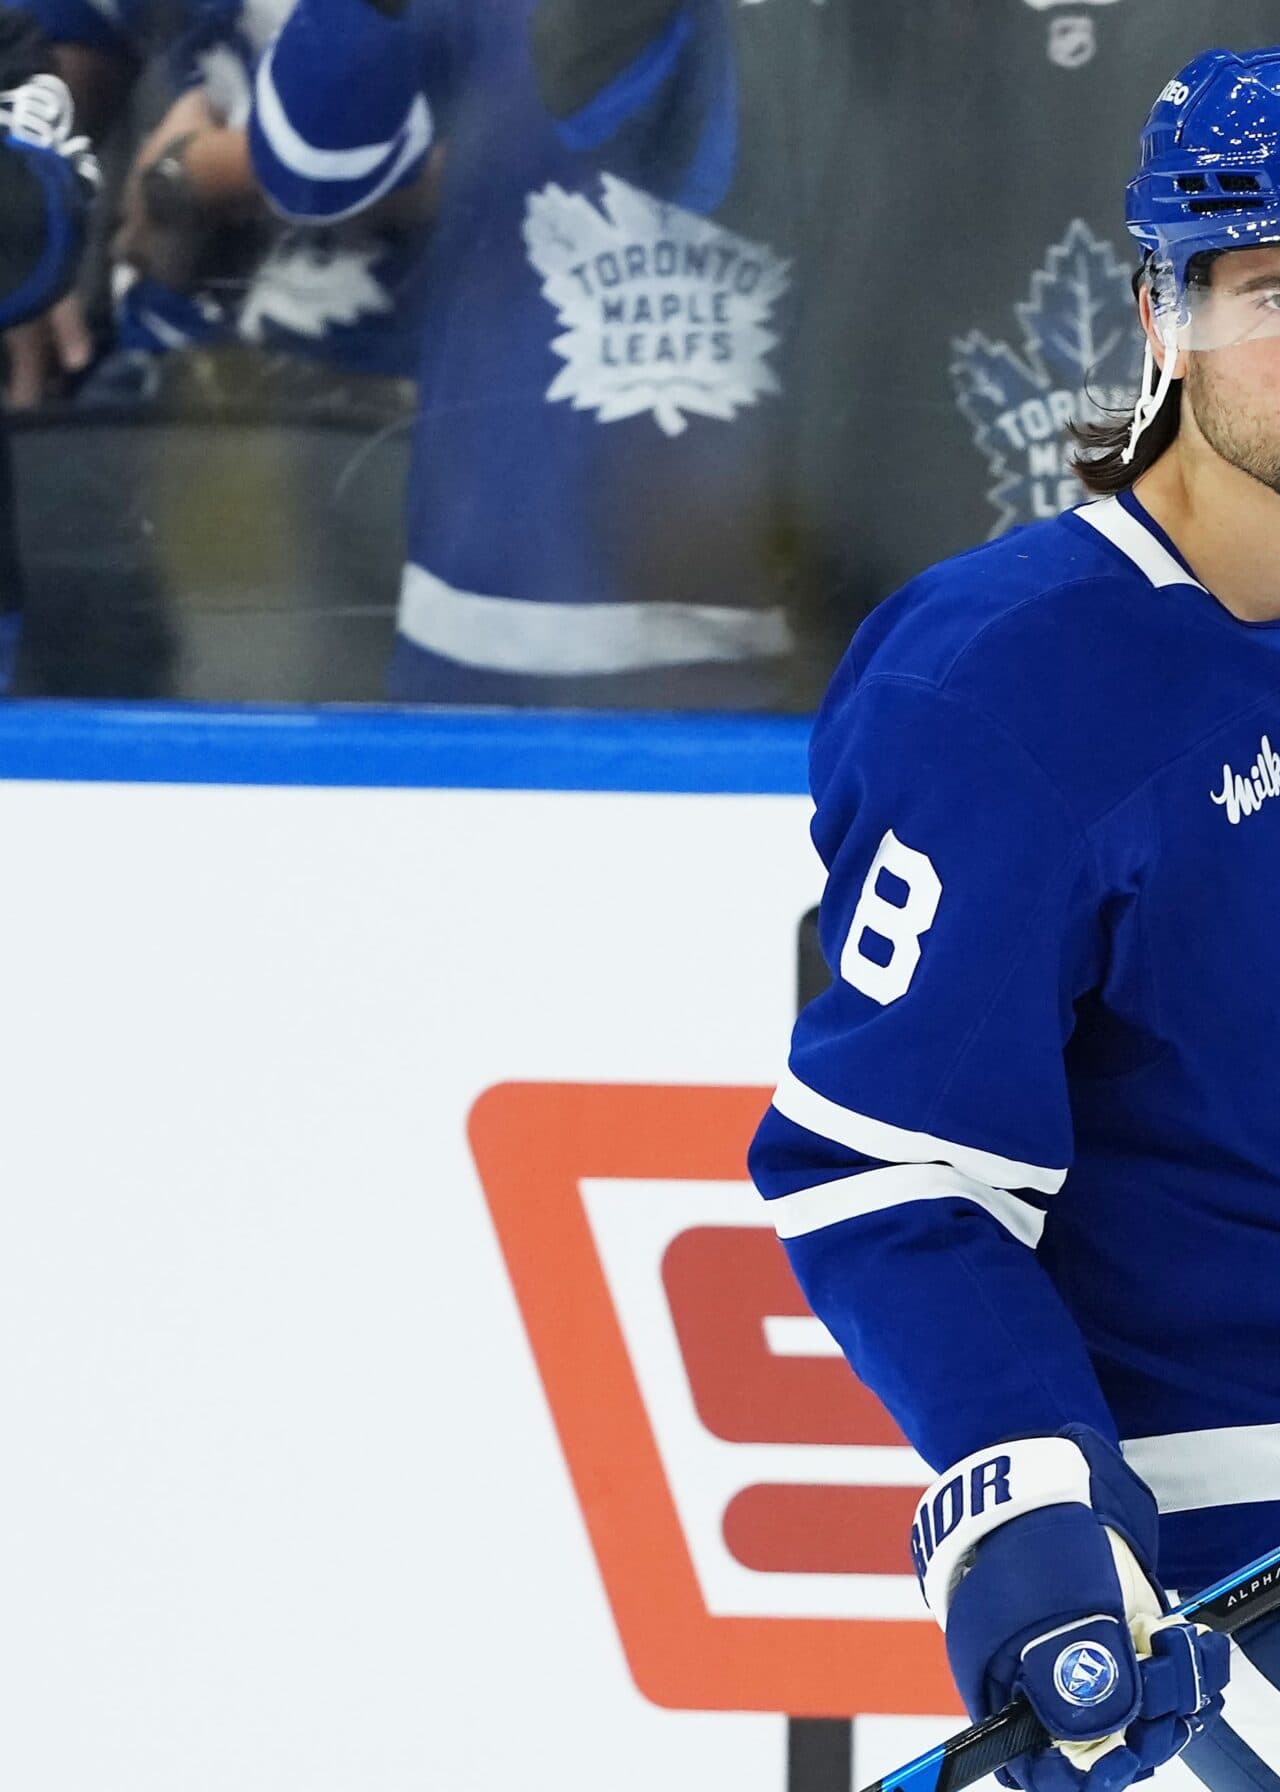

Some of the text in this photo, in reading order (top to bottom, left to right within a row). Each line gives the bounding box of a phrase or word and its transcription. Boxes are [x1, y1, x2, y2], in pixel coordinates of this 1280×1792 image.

[1157, 79, 1189, 105] REO
[569, 240, 762, 295] TORONTO
[601, 292, 730, 325] MAPLE
[601, 331, 733, 367] LEAFS
[840, 827, 944, 1007] 8
[910, 1455, 1013, 1579] RIOR
